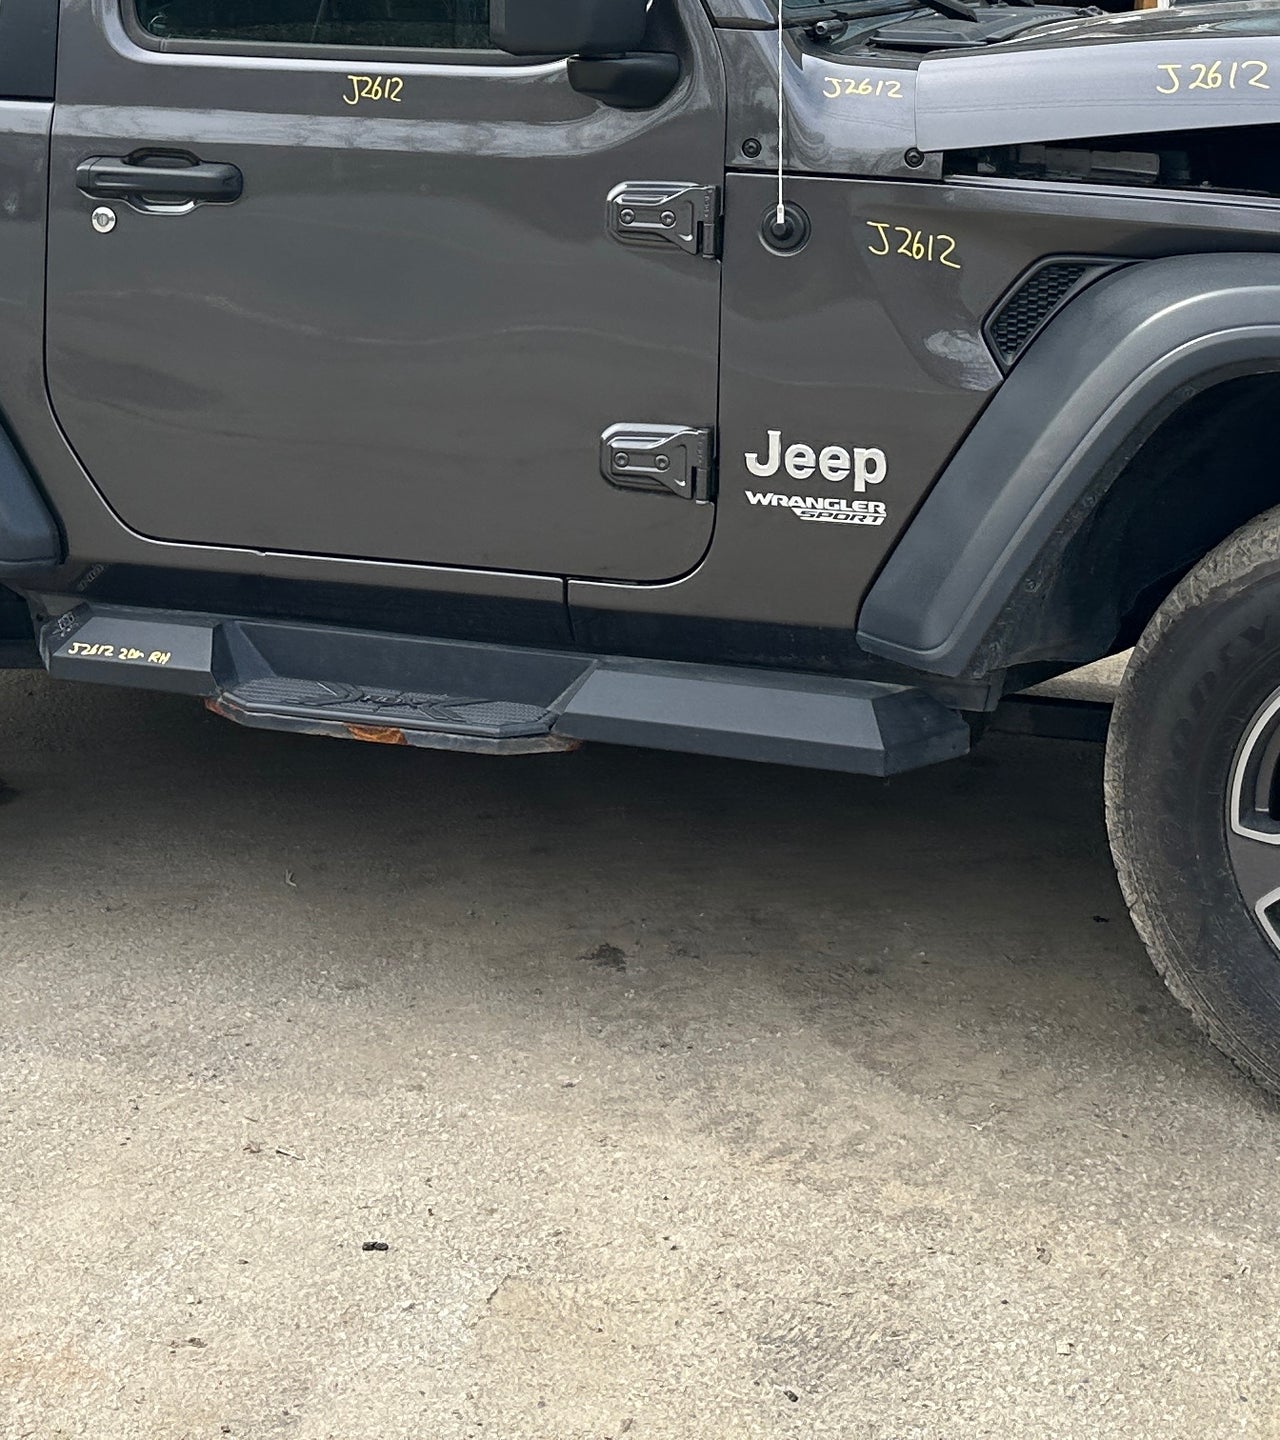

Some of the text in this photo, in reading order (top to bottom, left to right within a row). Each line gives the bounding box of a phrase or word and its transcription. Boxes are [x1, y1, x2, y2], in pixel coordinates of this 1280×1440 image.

[342, 75, 404, 105] J2612
[823, 77, 903, 98] J2612
[1156, 60, 1270, 94] J2612
[866, 221, 961, 269] J2612
[744, 429, 887, 492] Jeep
[744, 490, 887, 514] WRANGLER
[798, 510, 885, 523] SPORT
[147, 650, 171, 665] RH
